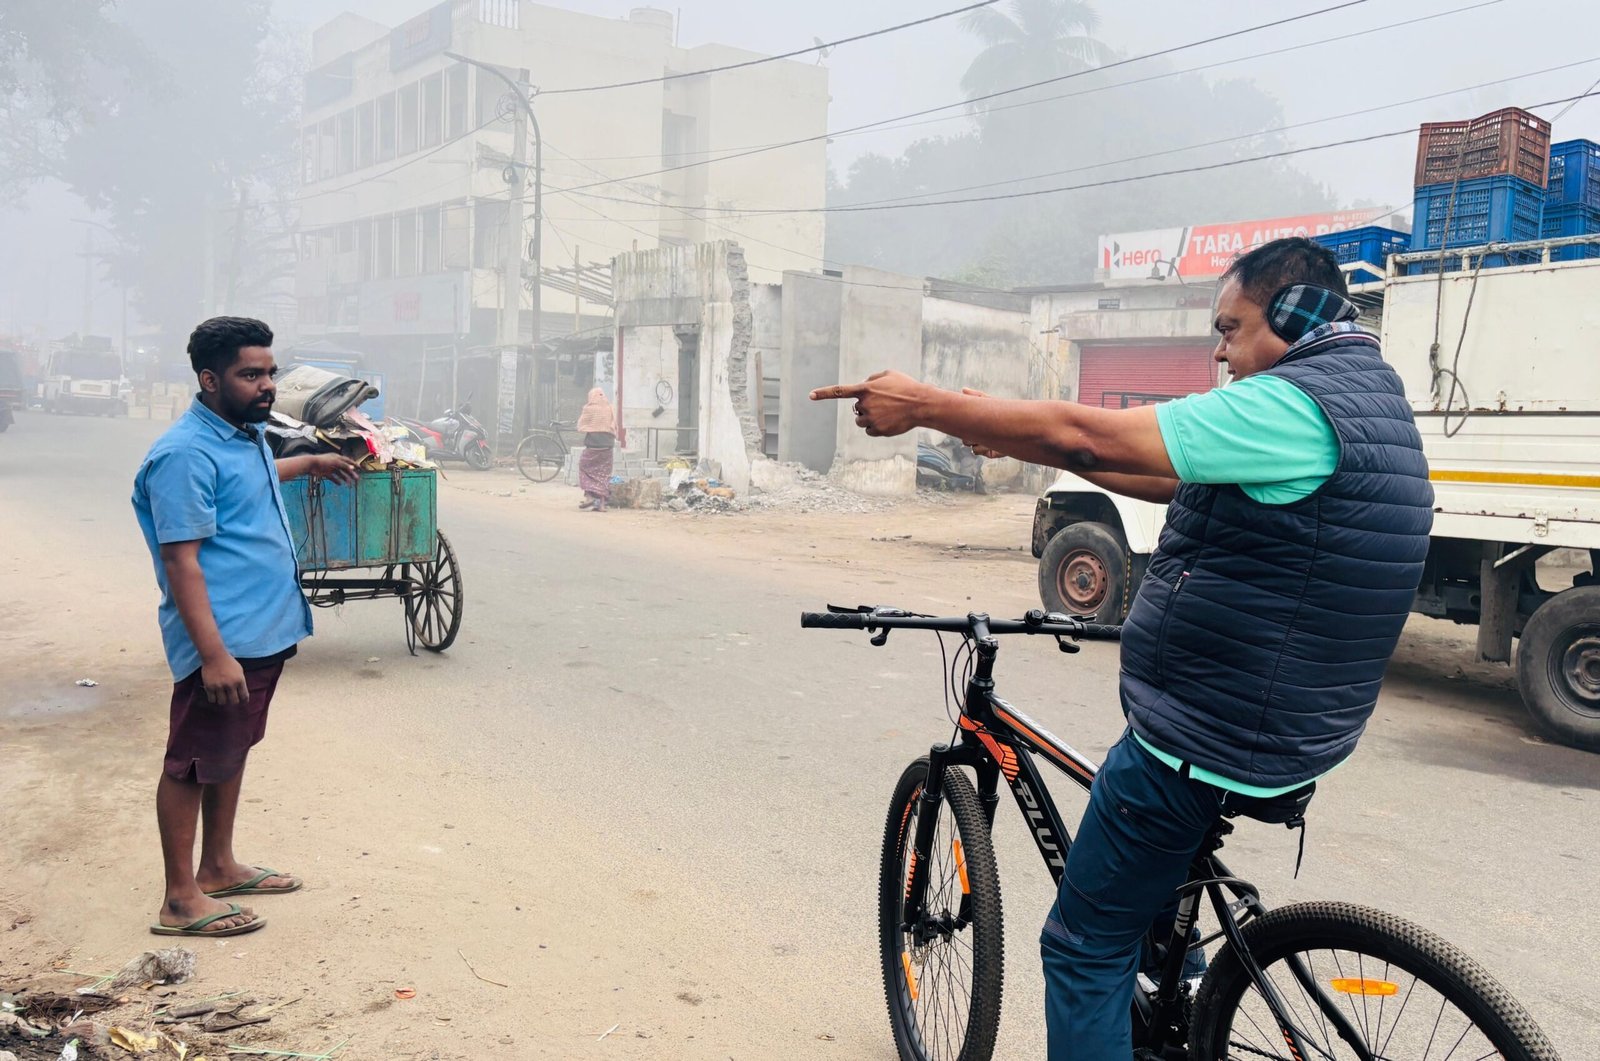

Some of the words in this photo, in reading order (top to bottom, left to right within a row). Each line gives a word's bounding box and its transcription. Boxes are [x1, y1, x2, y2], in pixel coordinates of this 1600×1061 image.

[1192, 232, 1244, 255] TARA
[1251, 226, 1309, 250] AUTO
[1123, 249, 1162, 266] Hero
[1015, 778, 1066, 882] PLUT
